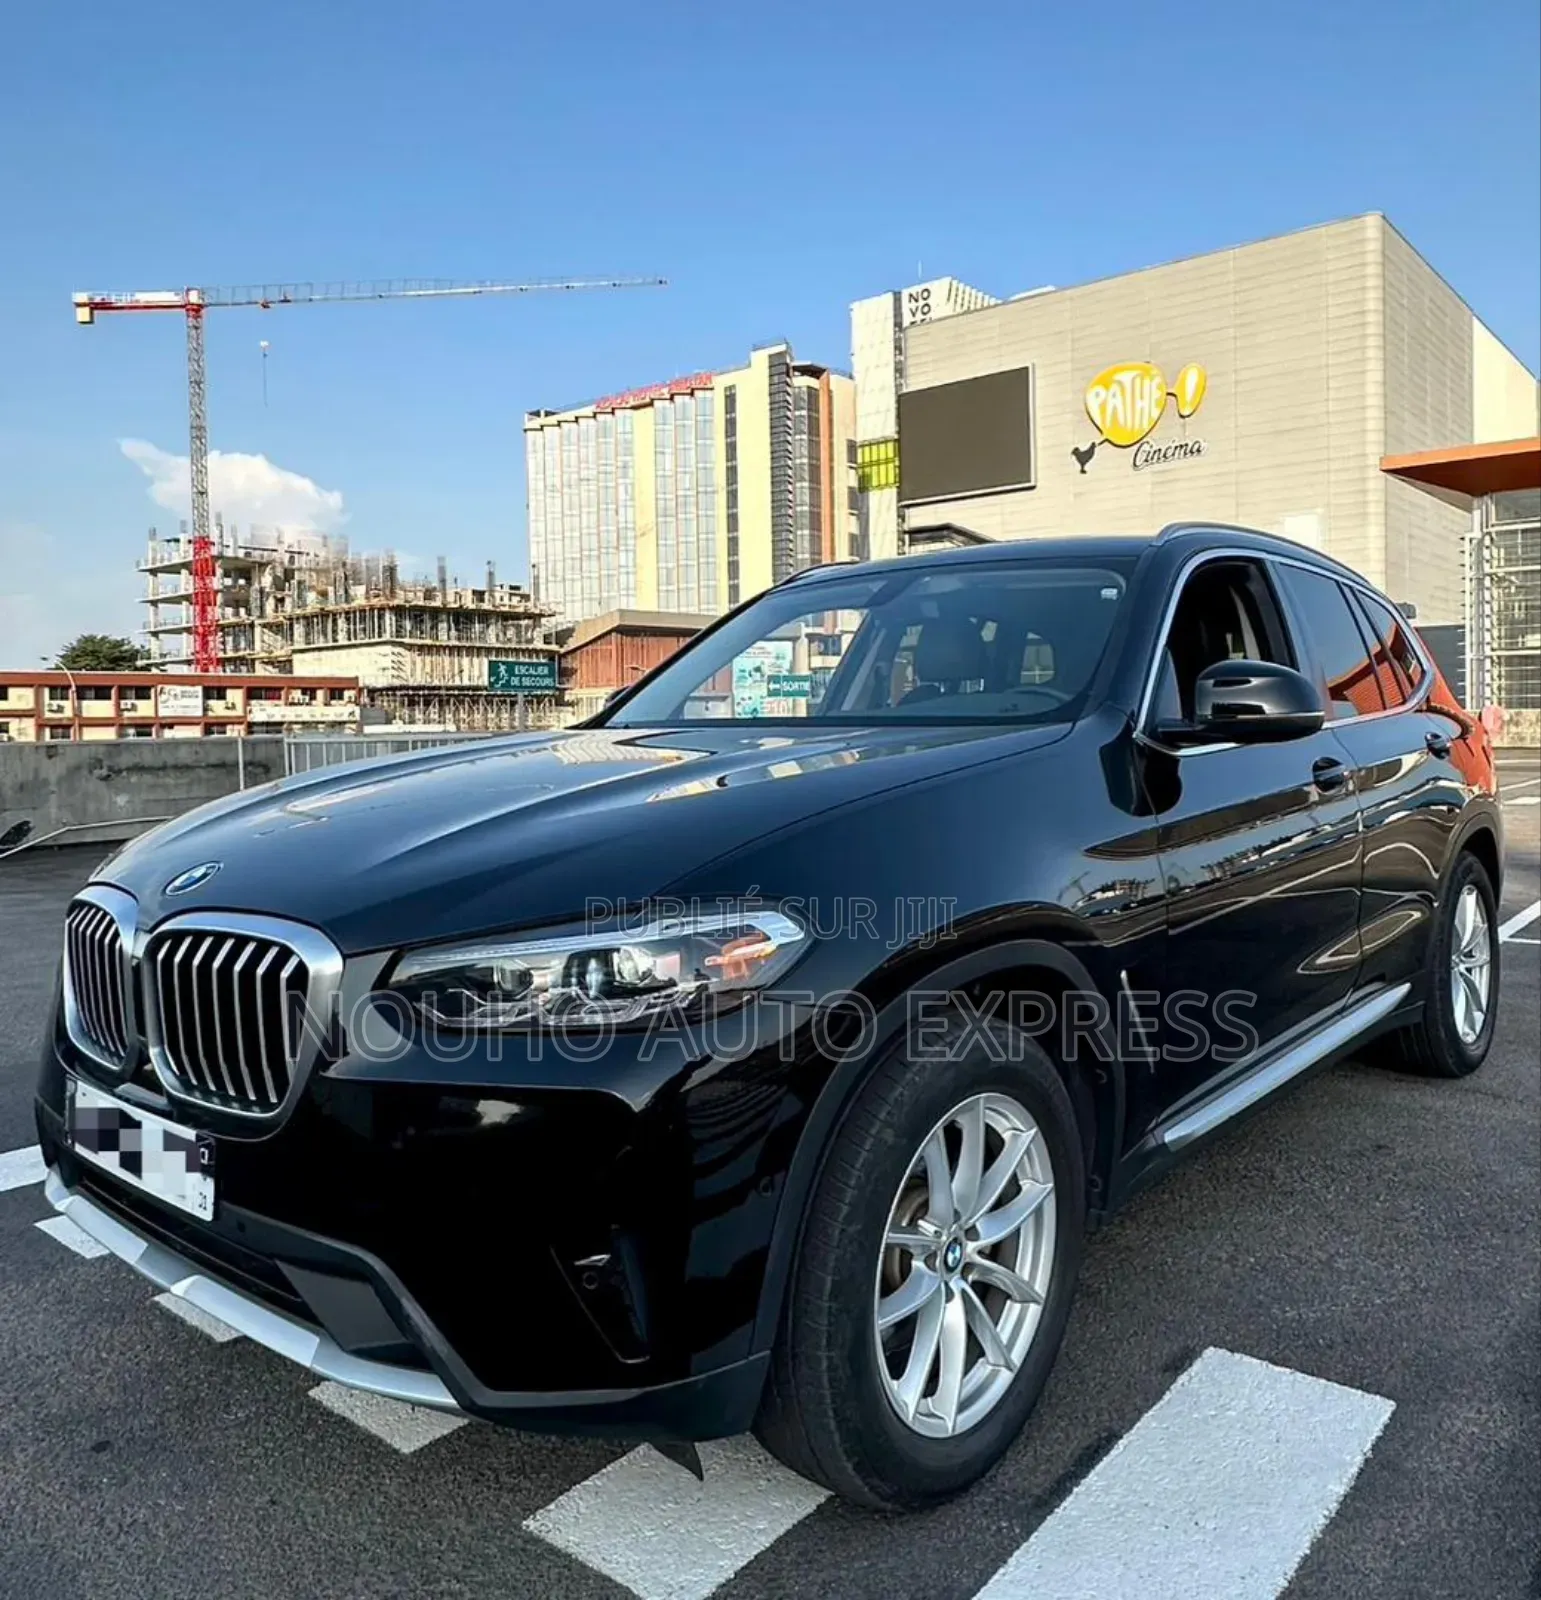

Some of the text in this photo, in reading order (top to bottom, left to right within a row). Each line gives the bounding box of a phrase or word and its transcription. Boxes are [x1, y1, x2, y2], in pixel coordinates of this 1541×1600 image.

[908, 288, 931, 303] NO
[908, 302, 931, 318] VO
[510, 676, 555, 687] DE SECOURS
[782, 681, 811, 692] SORTIE
